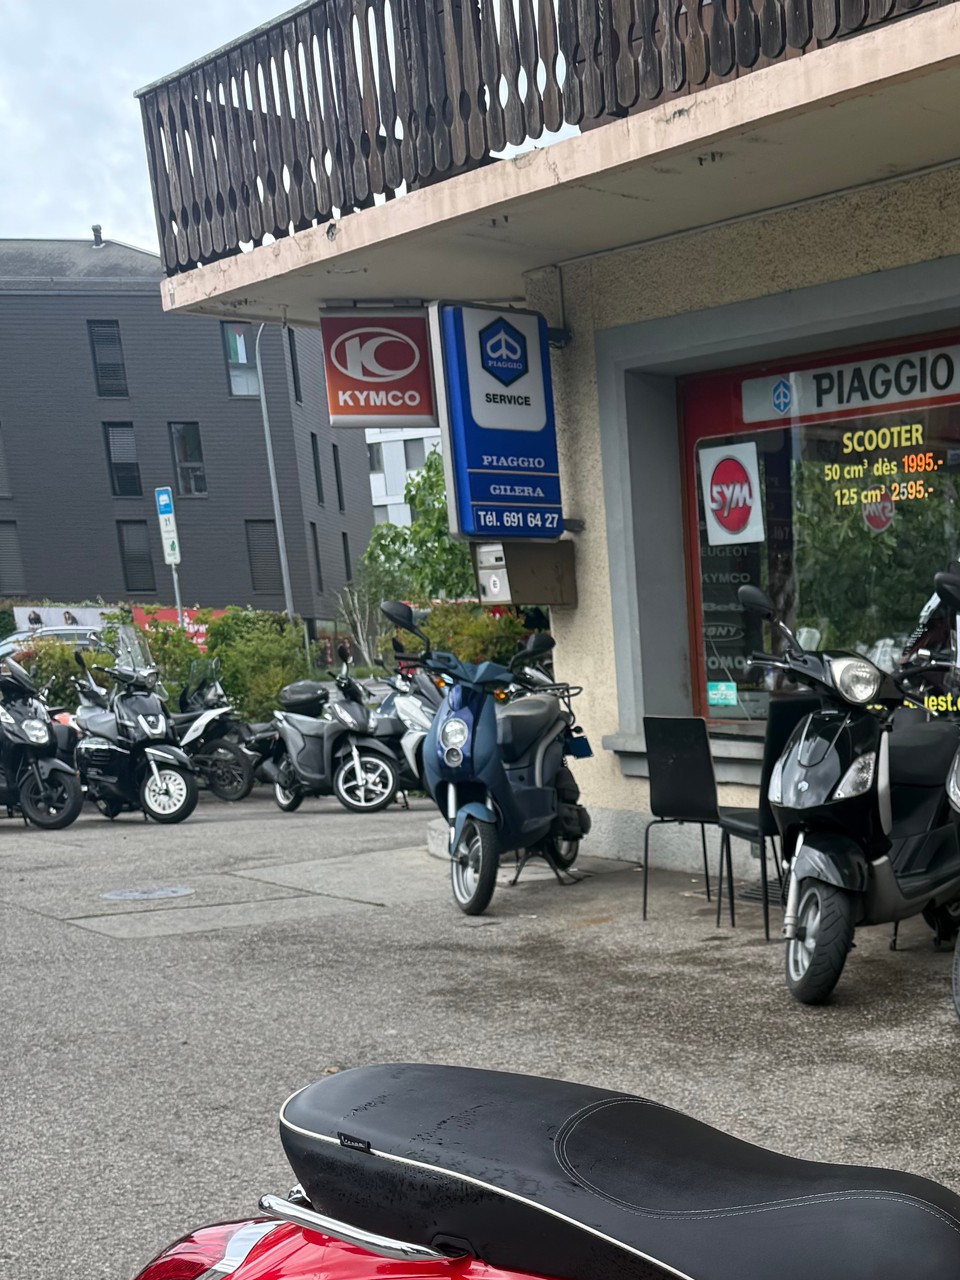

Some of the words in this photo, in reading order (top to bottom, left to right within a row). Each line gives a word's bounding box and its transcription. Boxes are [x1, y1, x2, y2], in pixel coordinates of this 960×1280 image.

[488, 359, 523, 370] PIAGGIO
[813, 353, 955, 408] PIAGGIO
[338, 390, 421, 407] KYMCO
[485, 393, 531, 406] SERVICE
[842, 424, 924, 454] SCOOTER
[482, 455, 545, 468] PIAGGIO
[824, 464, 840, 482] 50
[873, 457, 898, 477] dès
[902, 452, 944, 474] 1995.-
[489, 484, 544, 497] GILERA
[834, 488, 858, 506] 125
[891, 480, 934, 501] 2595.-
[710, 483, 753, 518] SYM
[478, 511, 500, 527] Tél.
[503, 512, 523, 527] 691
[527, 513, 542, 527] 64
[544, 513, 559, 528] 27
[700, 547, 749, 558] EUGEOT
